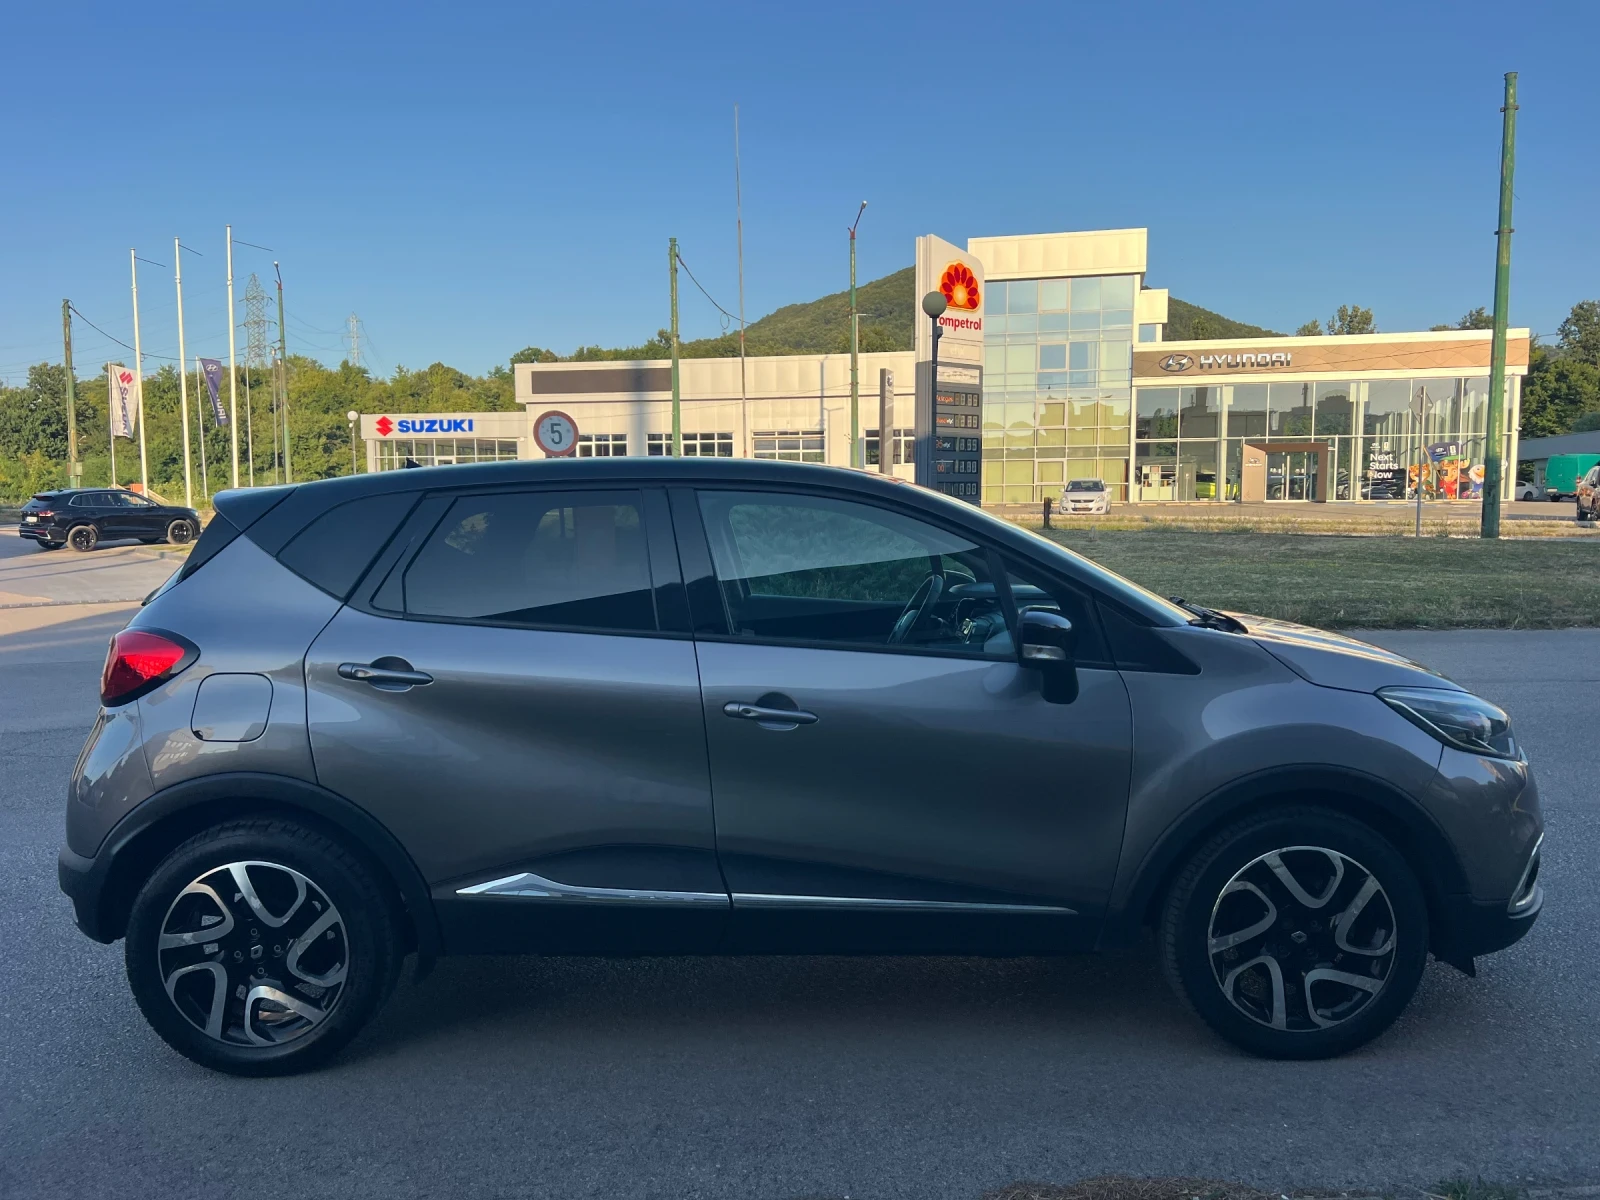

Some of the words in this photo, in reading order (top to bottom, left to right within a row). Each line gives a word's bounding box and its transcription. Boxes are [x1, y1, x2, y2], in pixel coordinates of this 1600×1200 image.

[938, 316, 981, 331] ompetrol
[1199, 352, 1292, 369] HYUNDAI
[398, 418, 474, 433] SUZUKI
[550, 422, 563, 445] 5
[1369, 453, 1393, 461] Next
[1369, 462, 1399, 470] Starts
